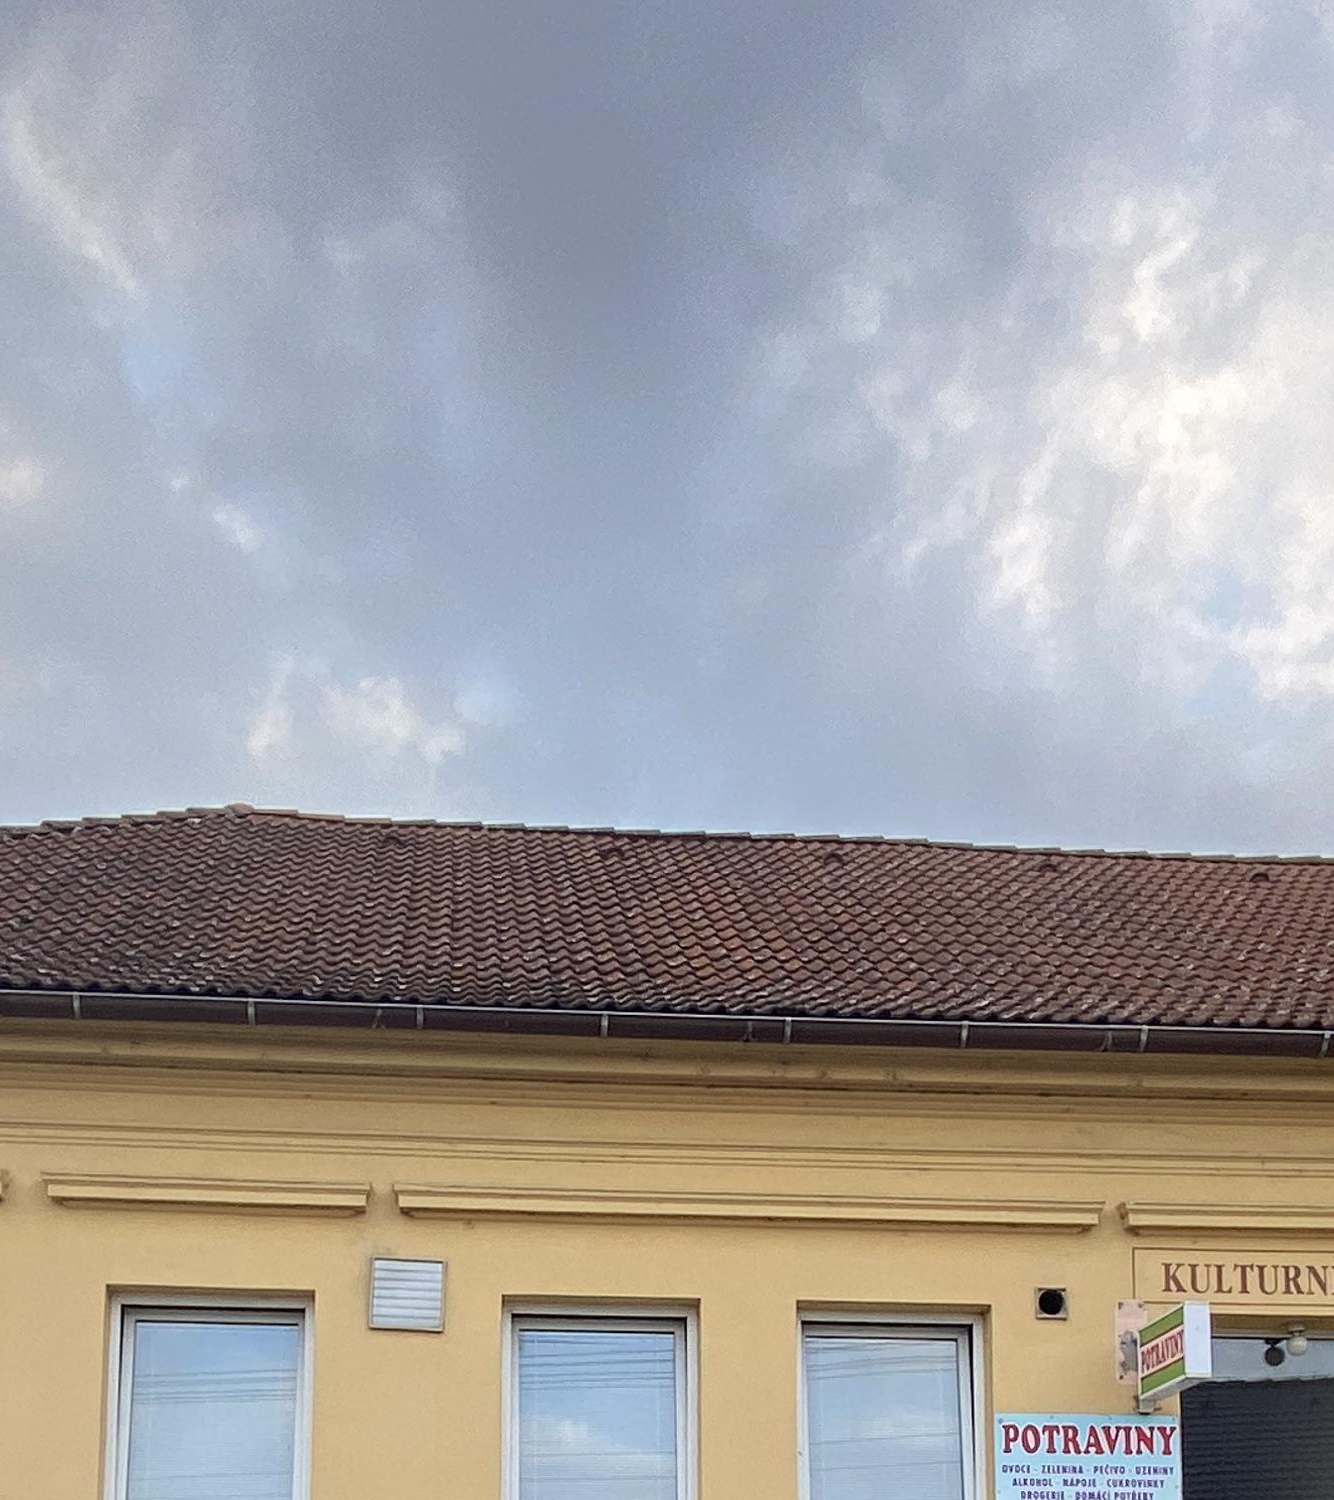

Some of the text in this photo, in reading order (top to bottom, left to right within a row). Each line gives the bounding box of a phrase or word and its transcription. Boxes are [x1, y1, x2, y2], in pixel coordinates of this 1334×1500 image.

[1001, 1424, 1177, 1455] POTRAVINY
[1001, 1464, 1174, 1476] OVOCE ZELENINA PEČIVO UZENINY
[1012, 1478, 1165, 1489] ALKOHOL NÁPOJE CUKROVINKY
[1021, 1490, 1154, 1500] DROGERIE DOMÁCÍ POTŘEBY
